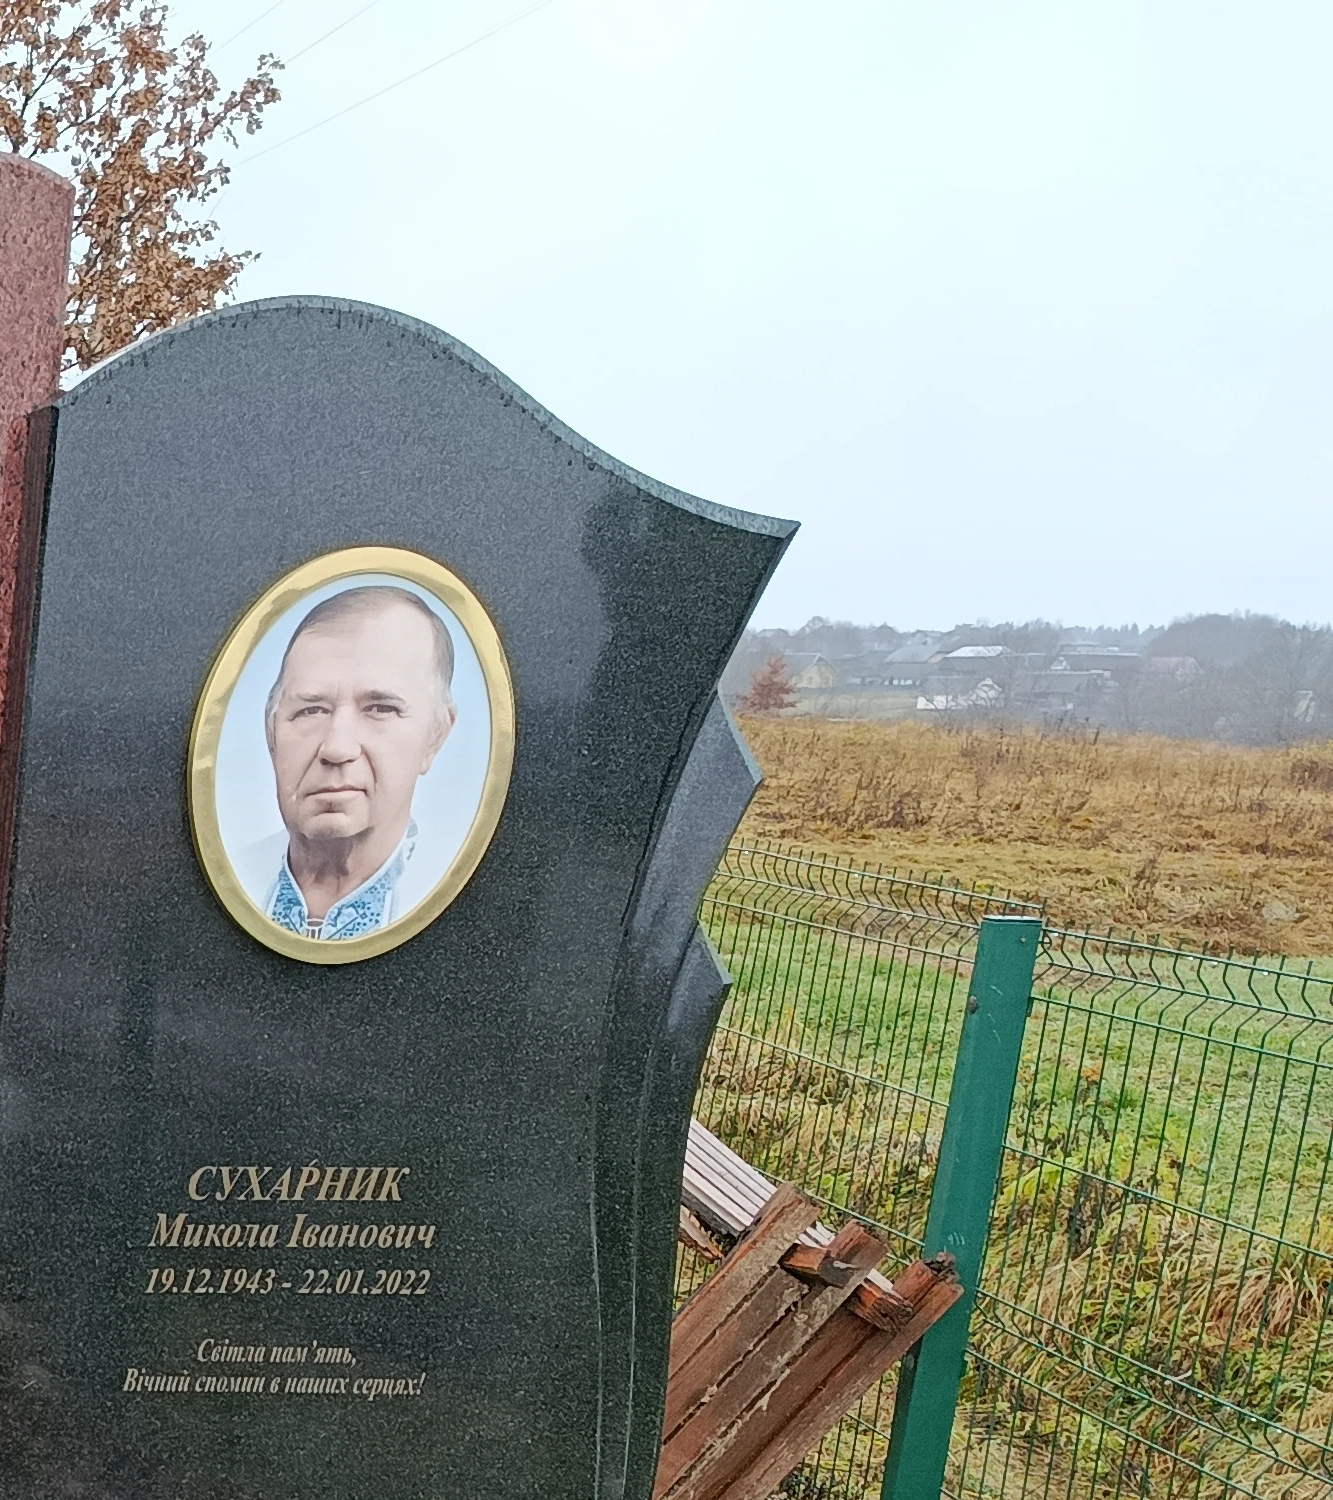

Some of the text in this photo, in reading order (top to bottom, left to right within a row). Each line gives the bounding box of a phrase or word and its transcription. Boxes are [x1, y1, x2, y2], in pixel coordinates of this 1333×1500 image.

[188, 1165, 410, 1202] СУХАРНИК
[148, 1213, 436, 1248] Микола Іванович
[145, 1268, 275, 1294] 19.12.1943
[297, 1269, 430, 1294] 22.01.2022
[197, 1339, 266, 1363] Світла
[123, 1369, 189, 1392] Вічний
